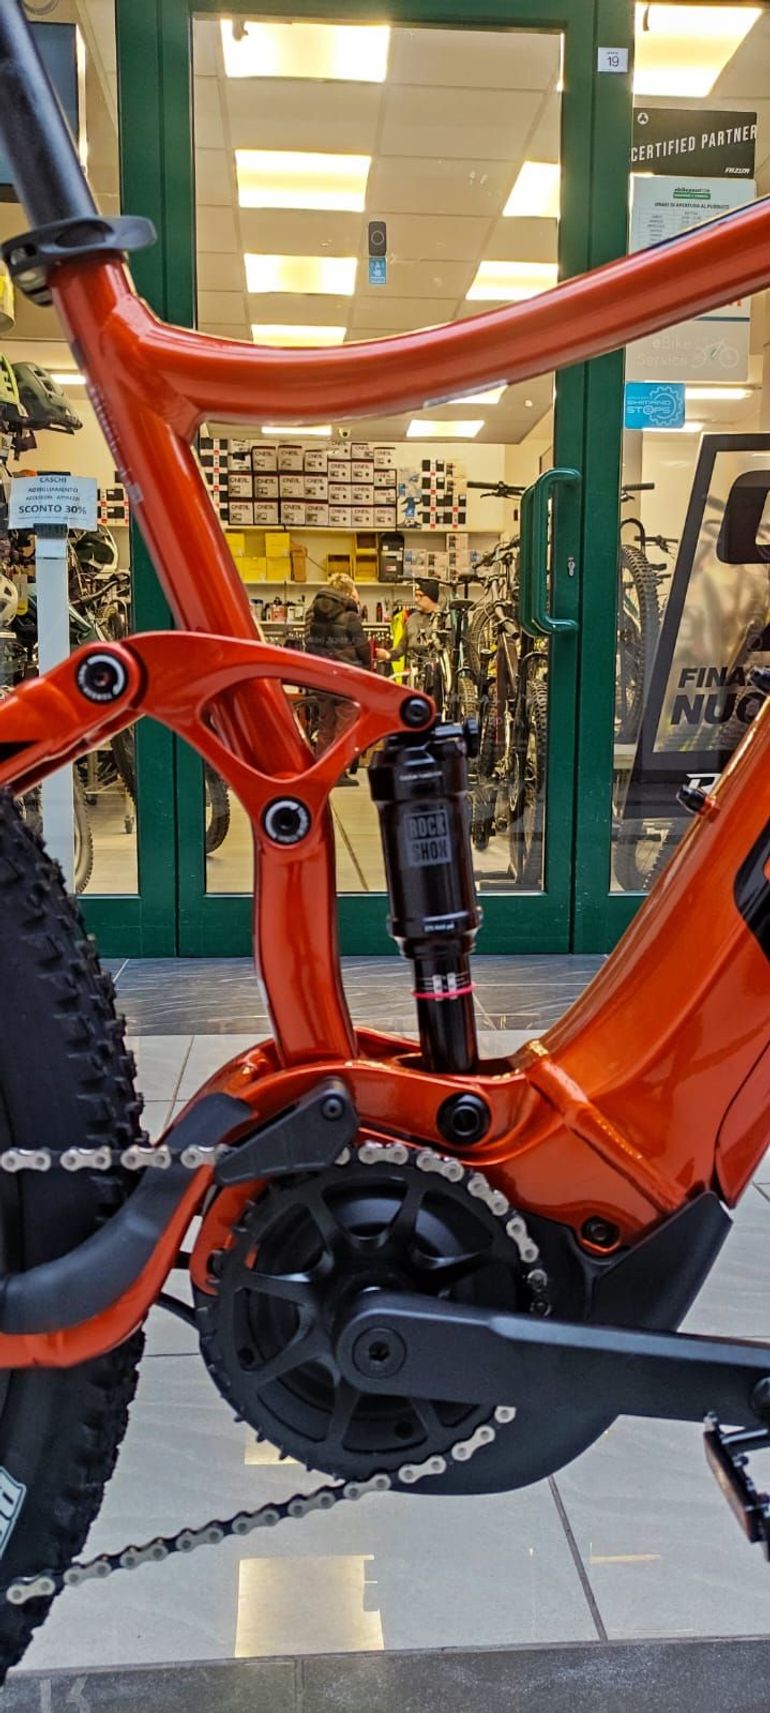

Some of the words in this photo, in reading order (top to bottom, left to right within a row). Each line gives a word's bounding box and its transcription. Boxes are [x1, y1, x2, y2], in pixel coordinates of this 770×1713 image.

[607, 55, 620, 67] 19
[631, 136, 696, 162] CERTIFIED
[701, 125, 757, 150] PARTNER
[18, 504, 62, 514] SCONTO
[65, 505, 87, 515] 30%
[678, 666, 753, 688] FINA
[408, 815, 446, 840] ROCK
[412, 838, 448, 863] SHOX
